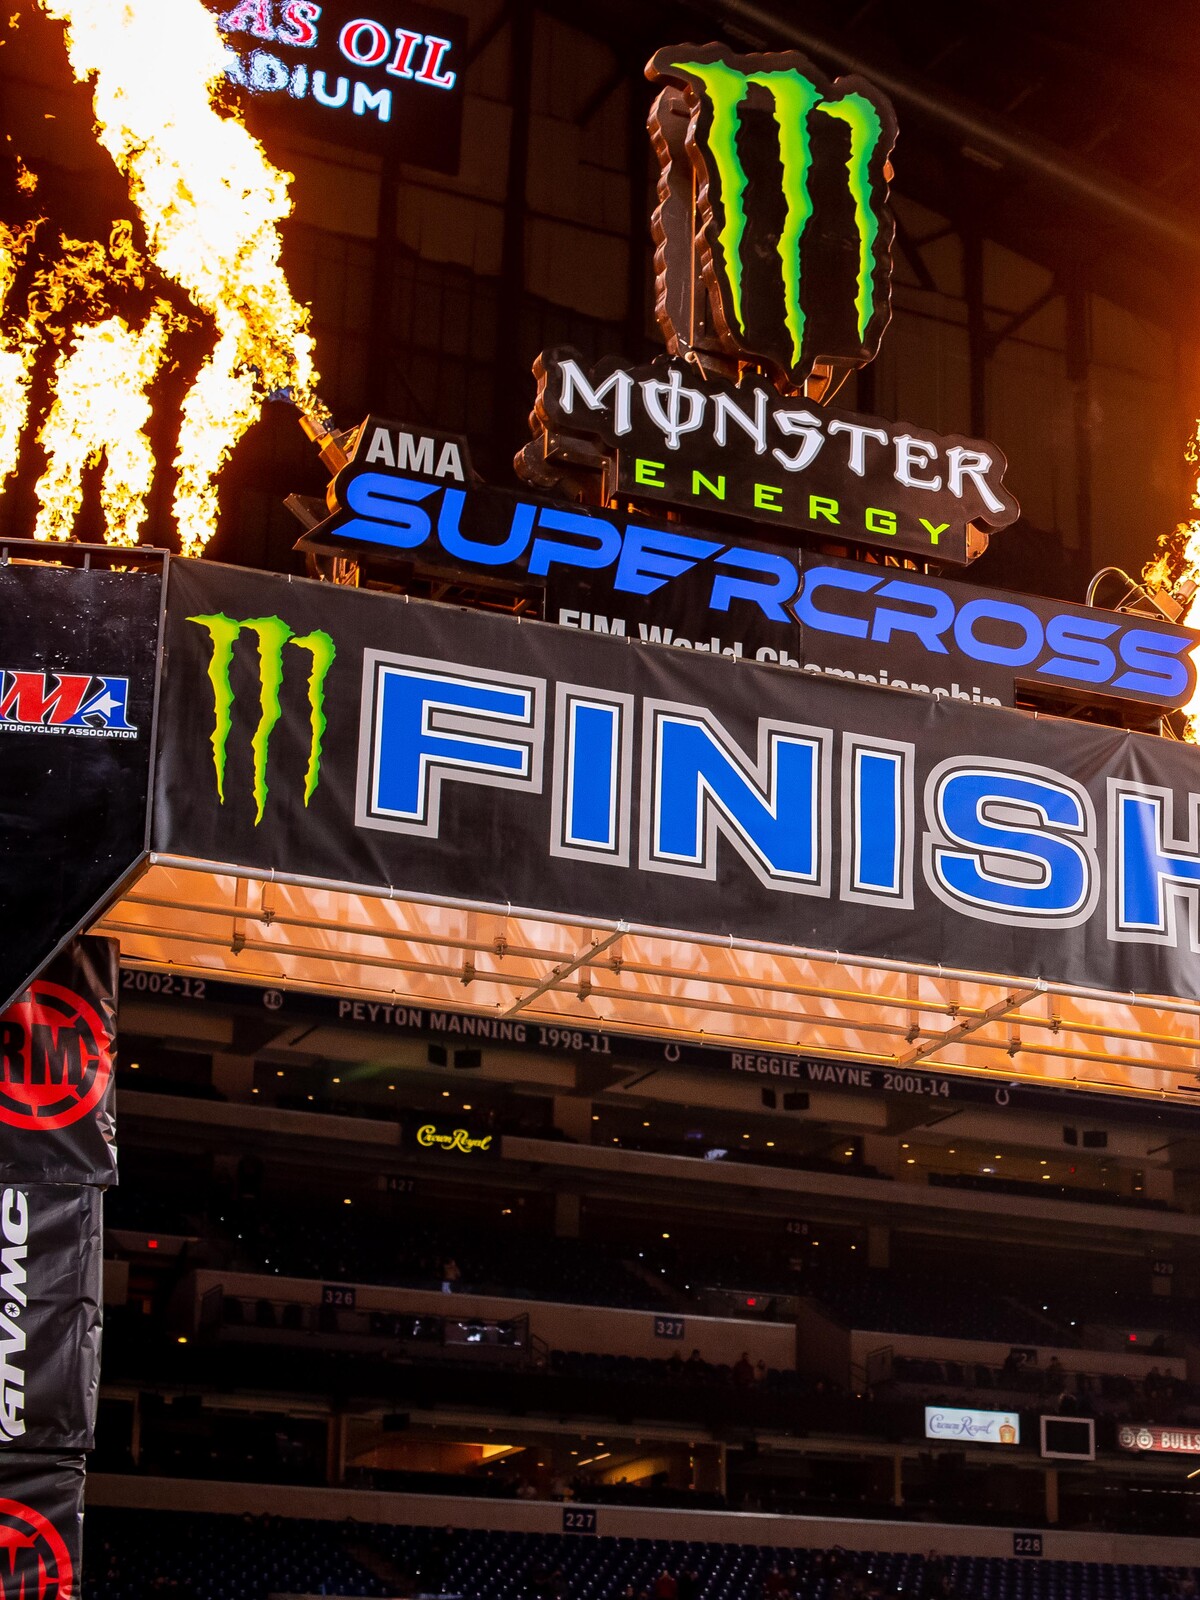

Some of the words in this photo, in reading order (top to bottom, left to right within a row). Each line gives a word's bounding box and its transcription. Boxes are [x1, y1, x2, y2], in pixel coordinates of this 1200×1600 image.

[338, 18, 457, 91] OIL
[365, 427, 466, 483] AMA
[556, 359, 1006, 515] MONSTER
[635, 458, 951, 547] ENERGY
[331, 471, 1198, 698] SUPERCROSS
[0, 669, 138, 730] MA
[0, 723, 66, 735] TORCYCLIST
[68, 727, 138, 739] ASSOCIATION
[122, 969, 207, 1000] 2002-12
[338, 999, 423, 1029] PEYTON
[429, 1011, 527, 1043] MANNING
[539, 1026, 612, 1054] 1998-11
[731, 1052, 801, 1079] REGGIE
[807, 1063, 872, 1088] WAYNE
[883, 1073, 950, 1098] 2001-14
[324, 1289, 354, 1306] 326
[656, 1320, 683, 1337] 327
[565, 1512, 595, 1528] 227
[1015, 1538, 1041, 1552] 228
